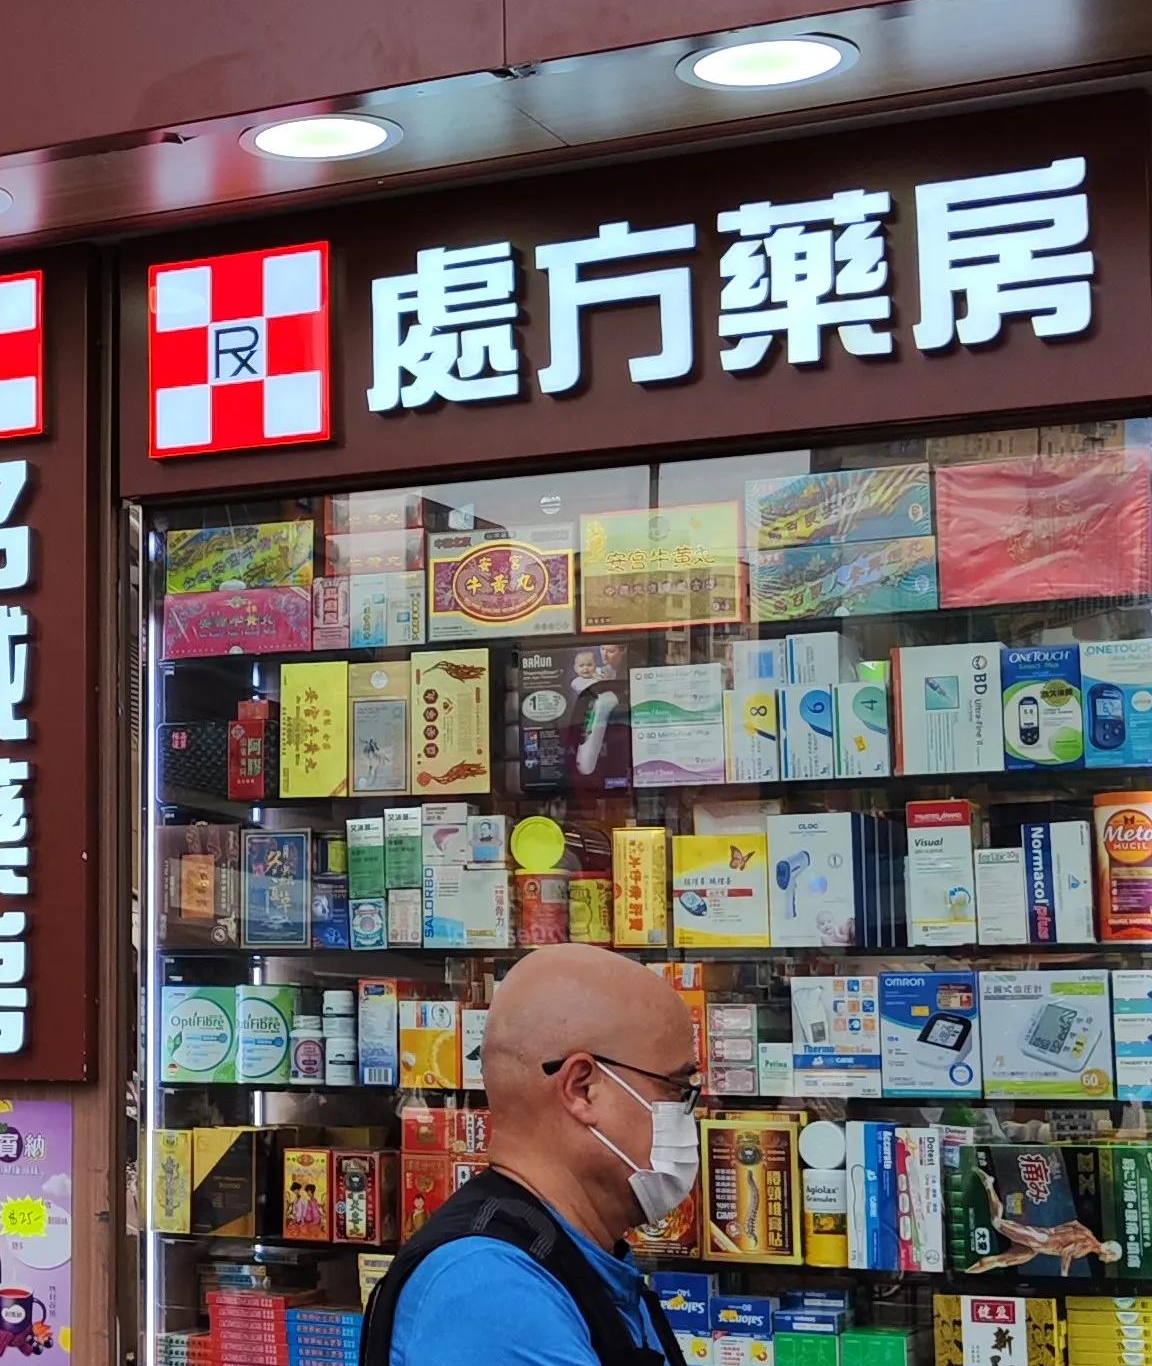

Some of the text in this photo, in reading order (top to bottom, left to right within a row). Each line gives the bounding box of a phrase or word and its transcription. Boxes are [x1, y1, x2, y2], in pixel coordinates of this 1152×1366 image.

[366, 157, 1094, 414] 處方藥房
[913, 837, 944, 848] Visual
[884, 977, 925, 988] OMRON
[170, 1011, 226, 1029] OptiFibre
